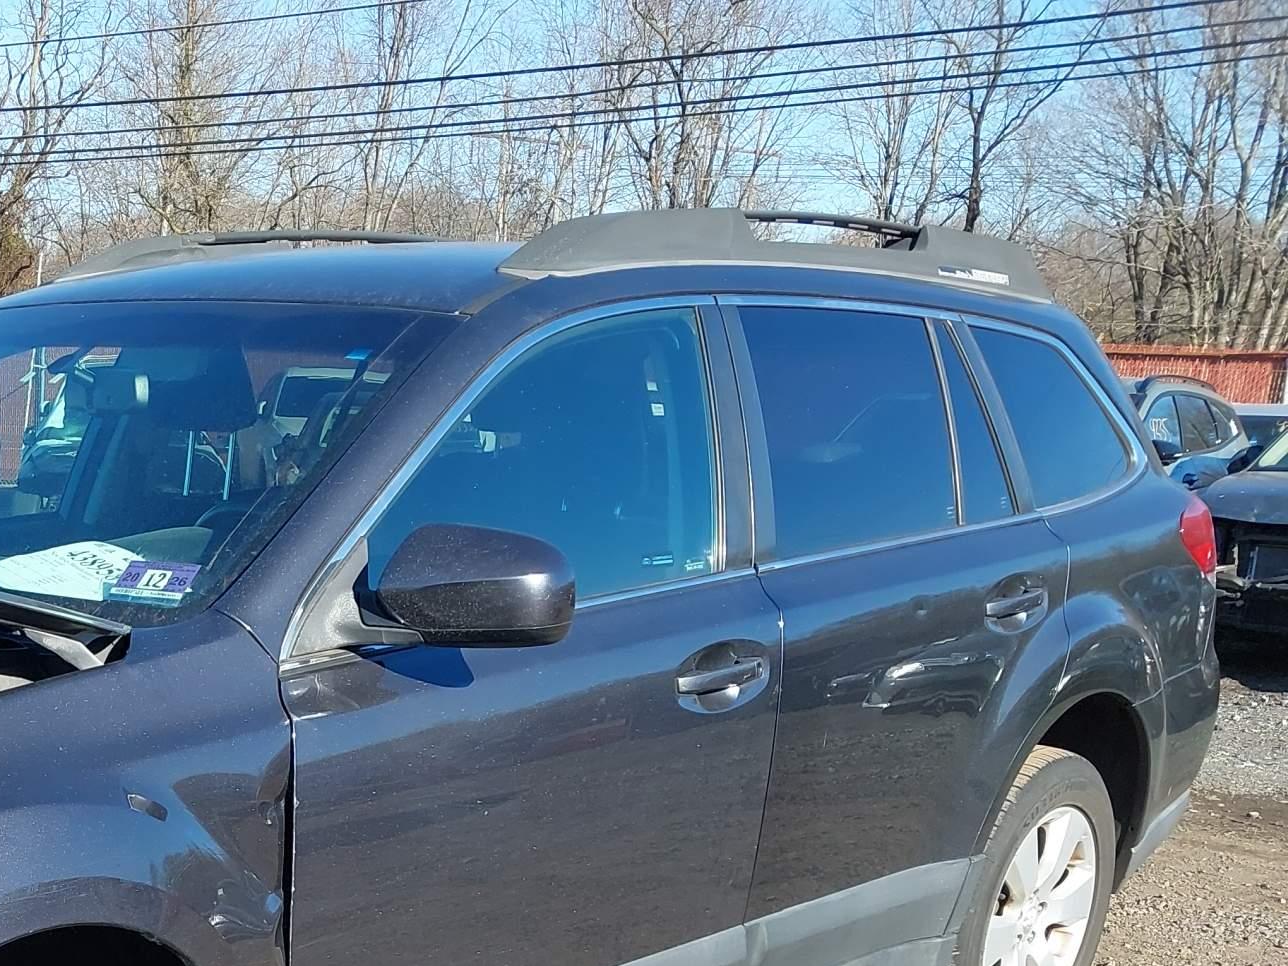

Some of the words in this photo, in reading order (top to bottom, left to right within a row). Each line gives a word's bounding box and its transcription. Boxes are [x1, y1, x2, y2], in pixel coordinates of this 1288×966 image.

[122, 571, 140, 583] 20
[143, 572, 167, 589] 12
[169, 576, 188, 587] 26
